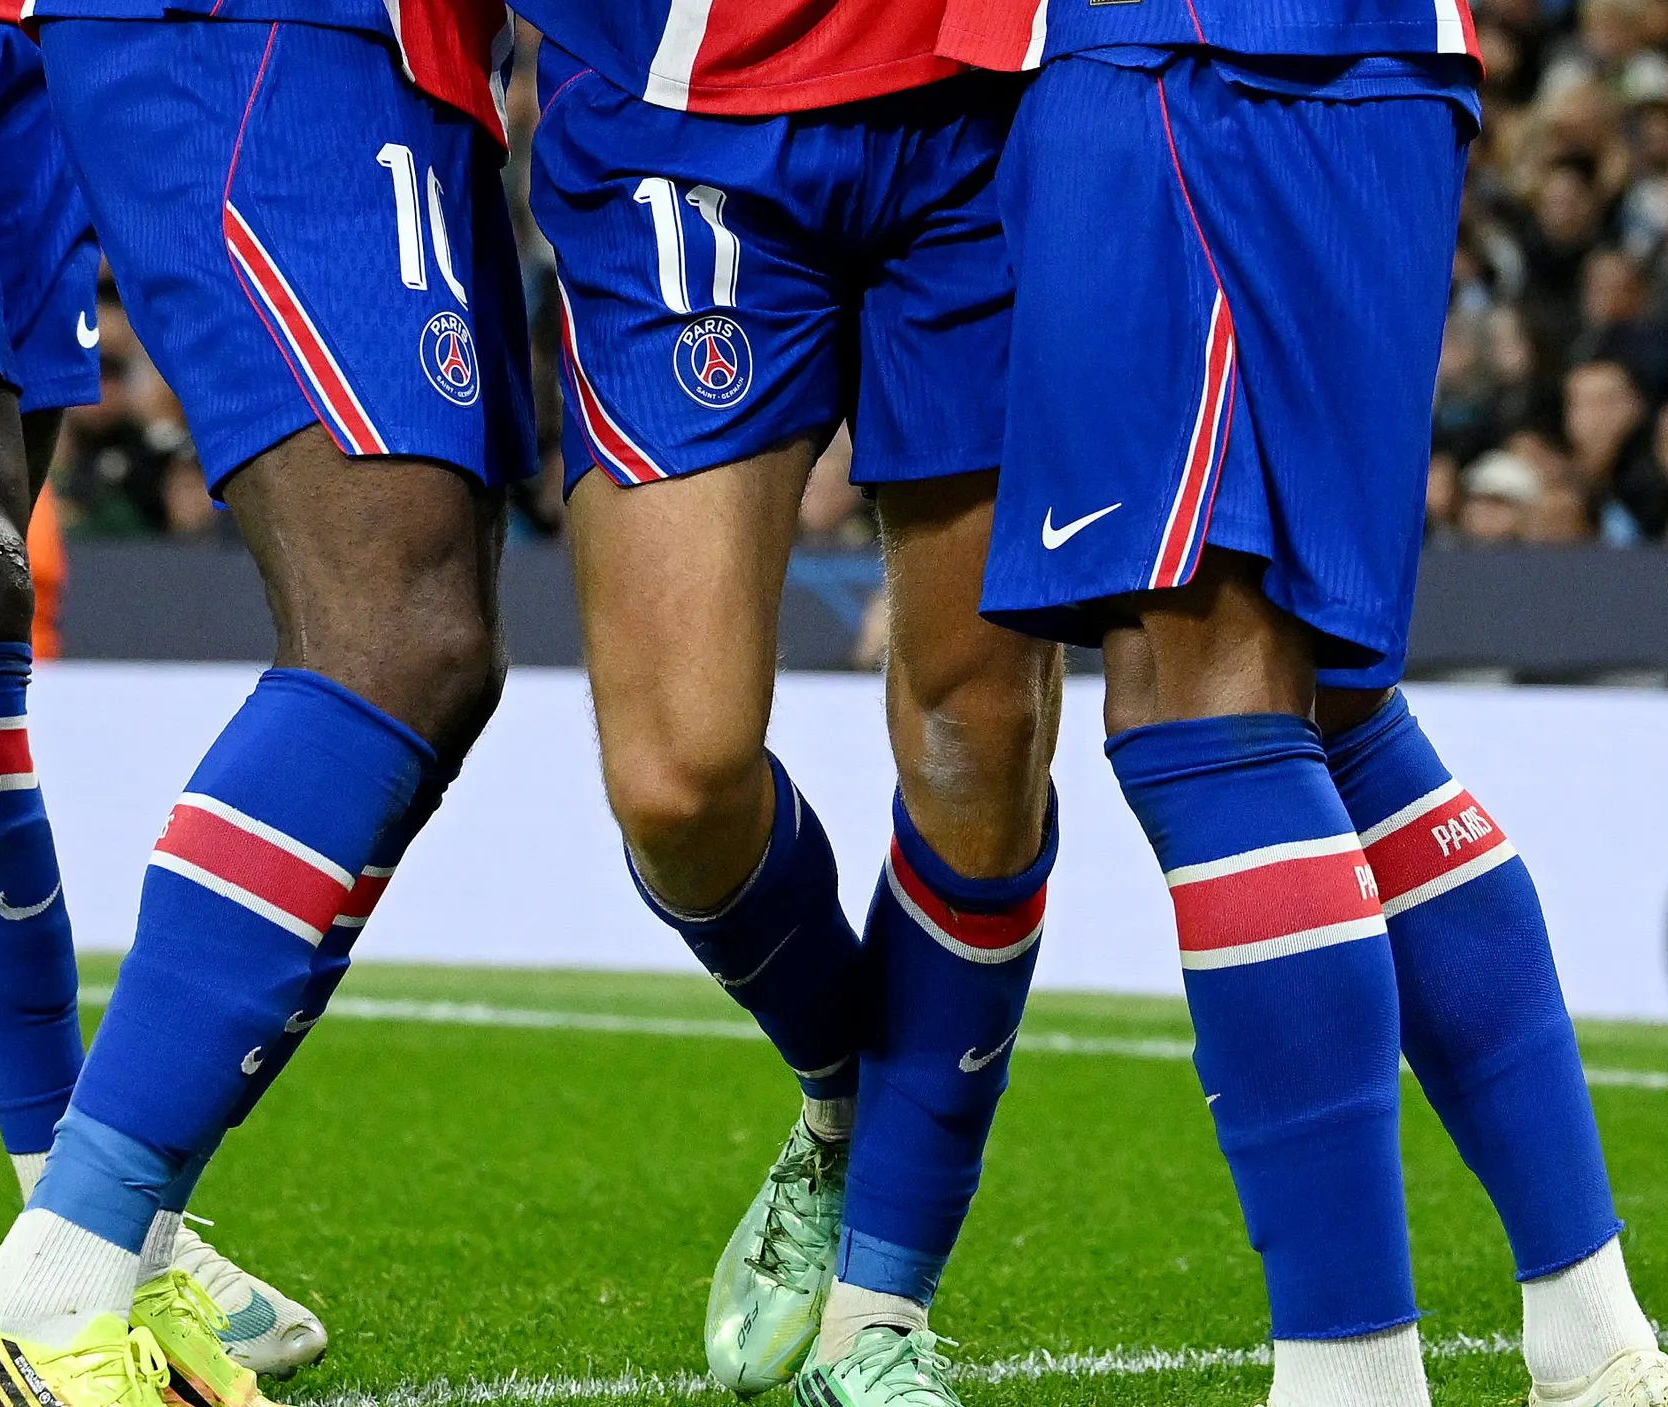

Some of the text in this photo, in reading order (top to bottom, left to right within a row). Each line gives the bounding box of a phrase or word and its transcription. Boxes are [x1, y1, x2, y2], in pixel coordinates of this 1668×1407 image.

[632, 177, 740, 314] 11
[430, 316, 469, 343] PARIS
[683, 319, 734, 347] PARIS
[1431, 805, 1493, 858] PARIS
